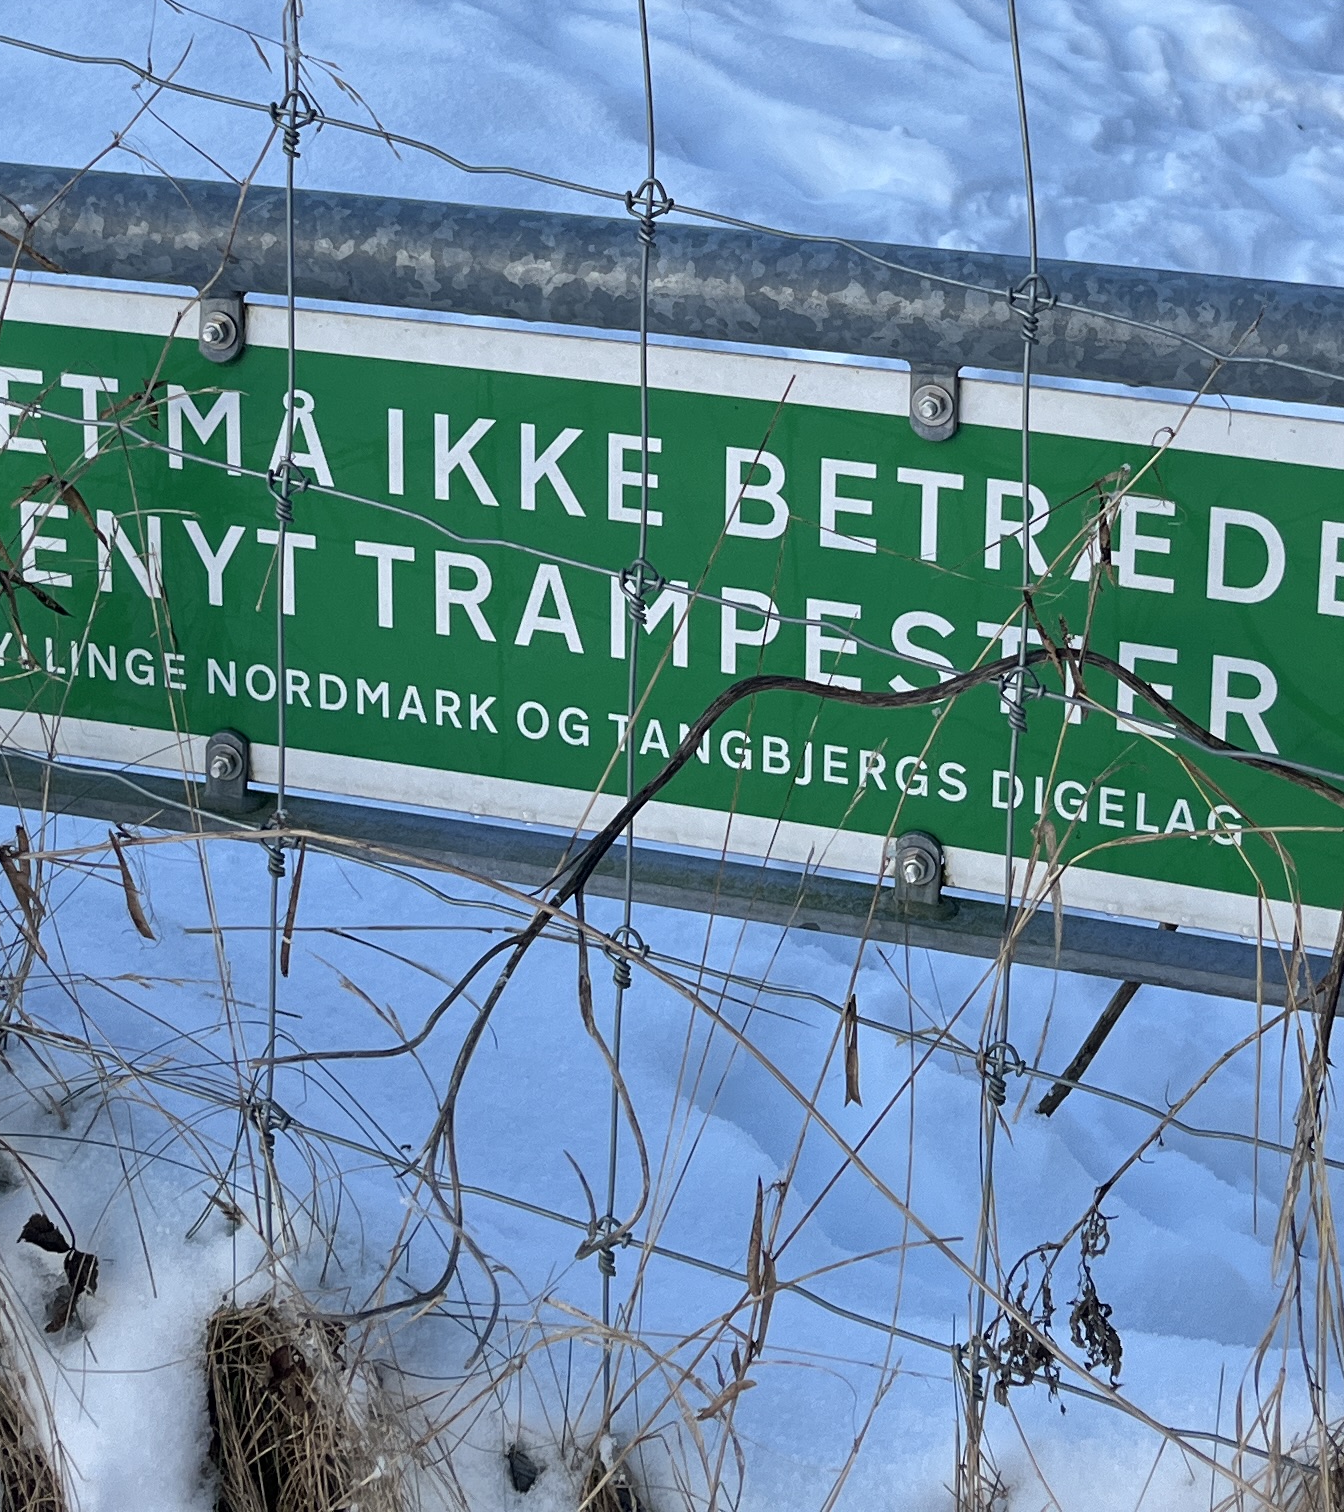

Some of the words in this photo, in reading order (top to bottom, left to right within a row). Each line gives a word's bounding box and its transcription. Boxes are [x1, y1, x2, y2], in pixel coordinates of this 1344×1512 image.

[166, 384, 335, 487] MÅ
[387, 407, 664, 527] IKKE
[355, 539, 1279, 755] TRAMPESTIER
[207, 657, 498, 735] NORDMARK
[516, 700, 591, 747] OG
[607, 712, 968, 803] TANGBJERGS
[991, 768, 1243, 847] DIGELAG
